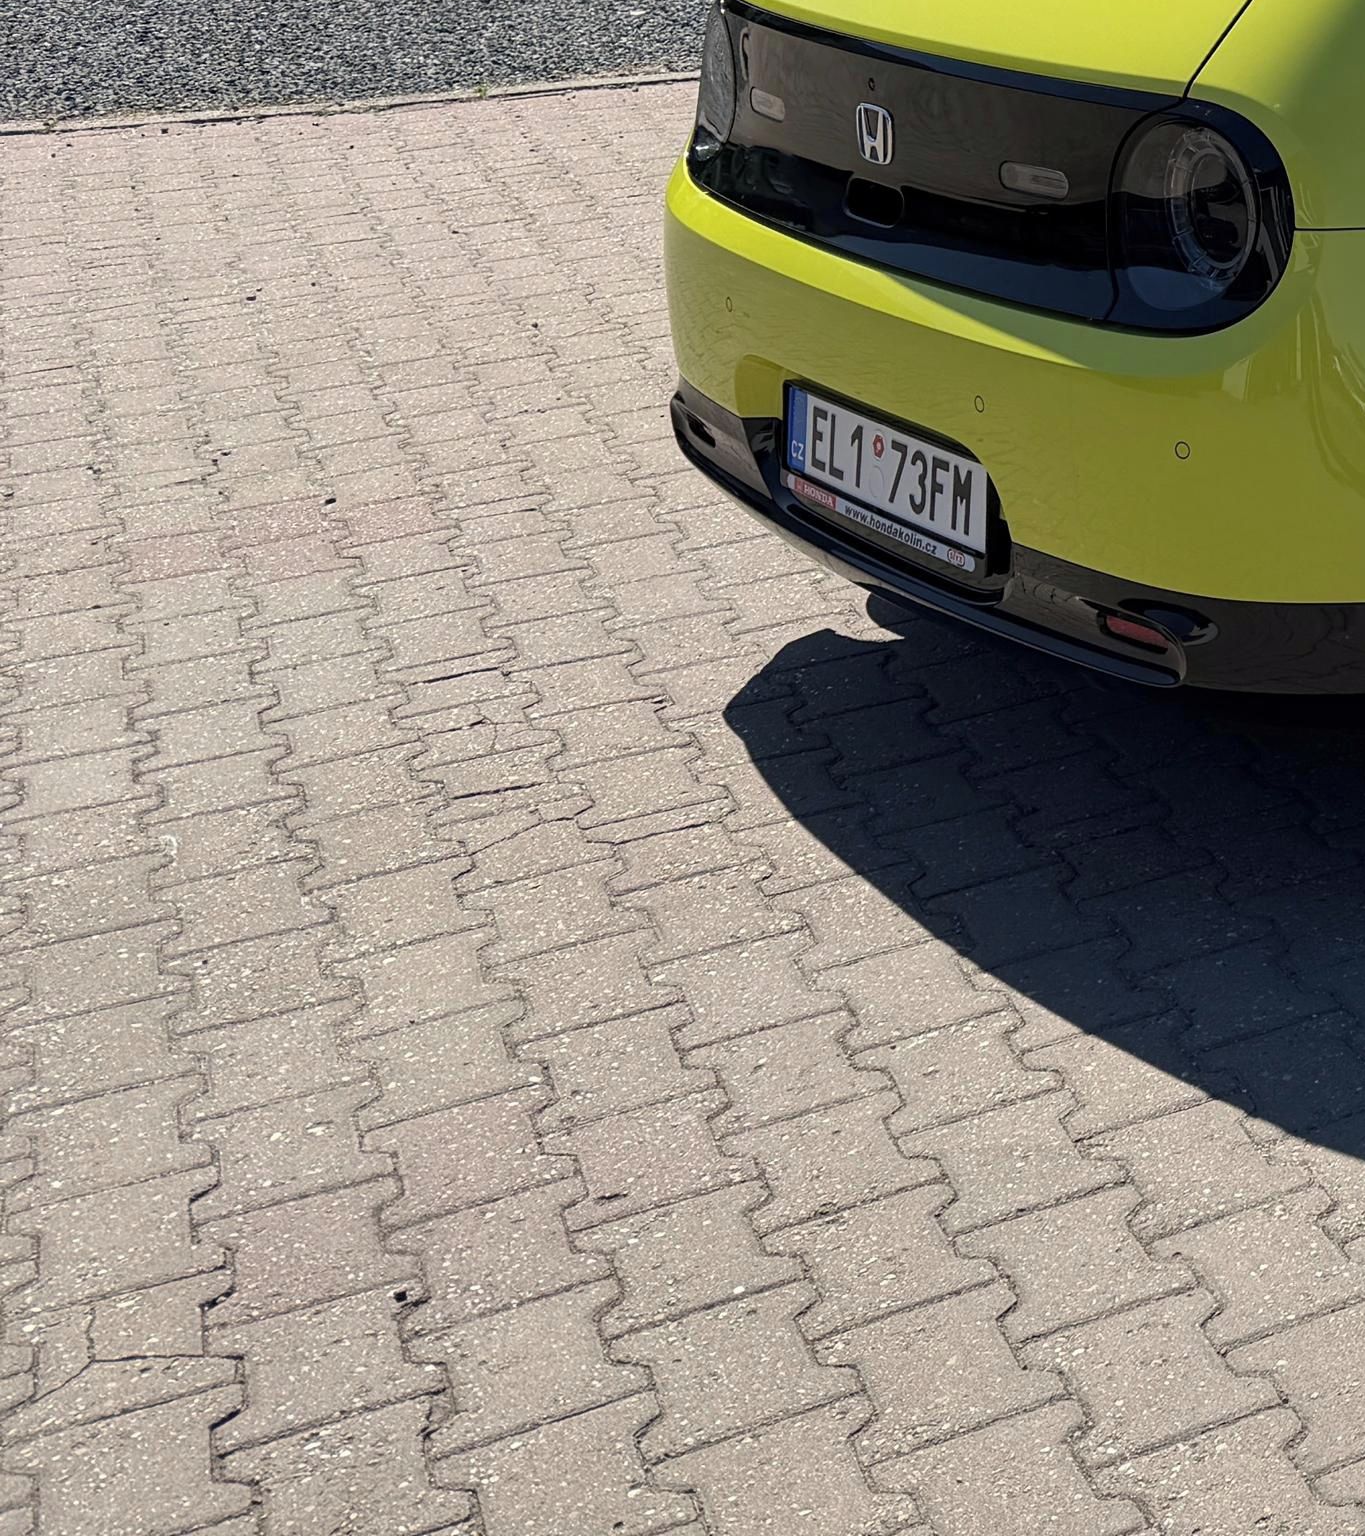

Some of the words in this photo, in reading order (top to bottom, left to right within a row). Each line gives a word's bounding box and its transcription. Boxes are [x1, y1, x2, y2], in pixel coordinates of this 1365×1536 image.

[791, 439, 805, 461] CZ
[811, 405, 864, 489] EL1
[888, 438, 973, 537] 73FM
[803, 483, 834, 507] HONDA
[844, 504, 938, 555] www.hondakolin.cz
